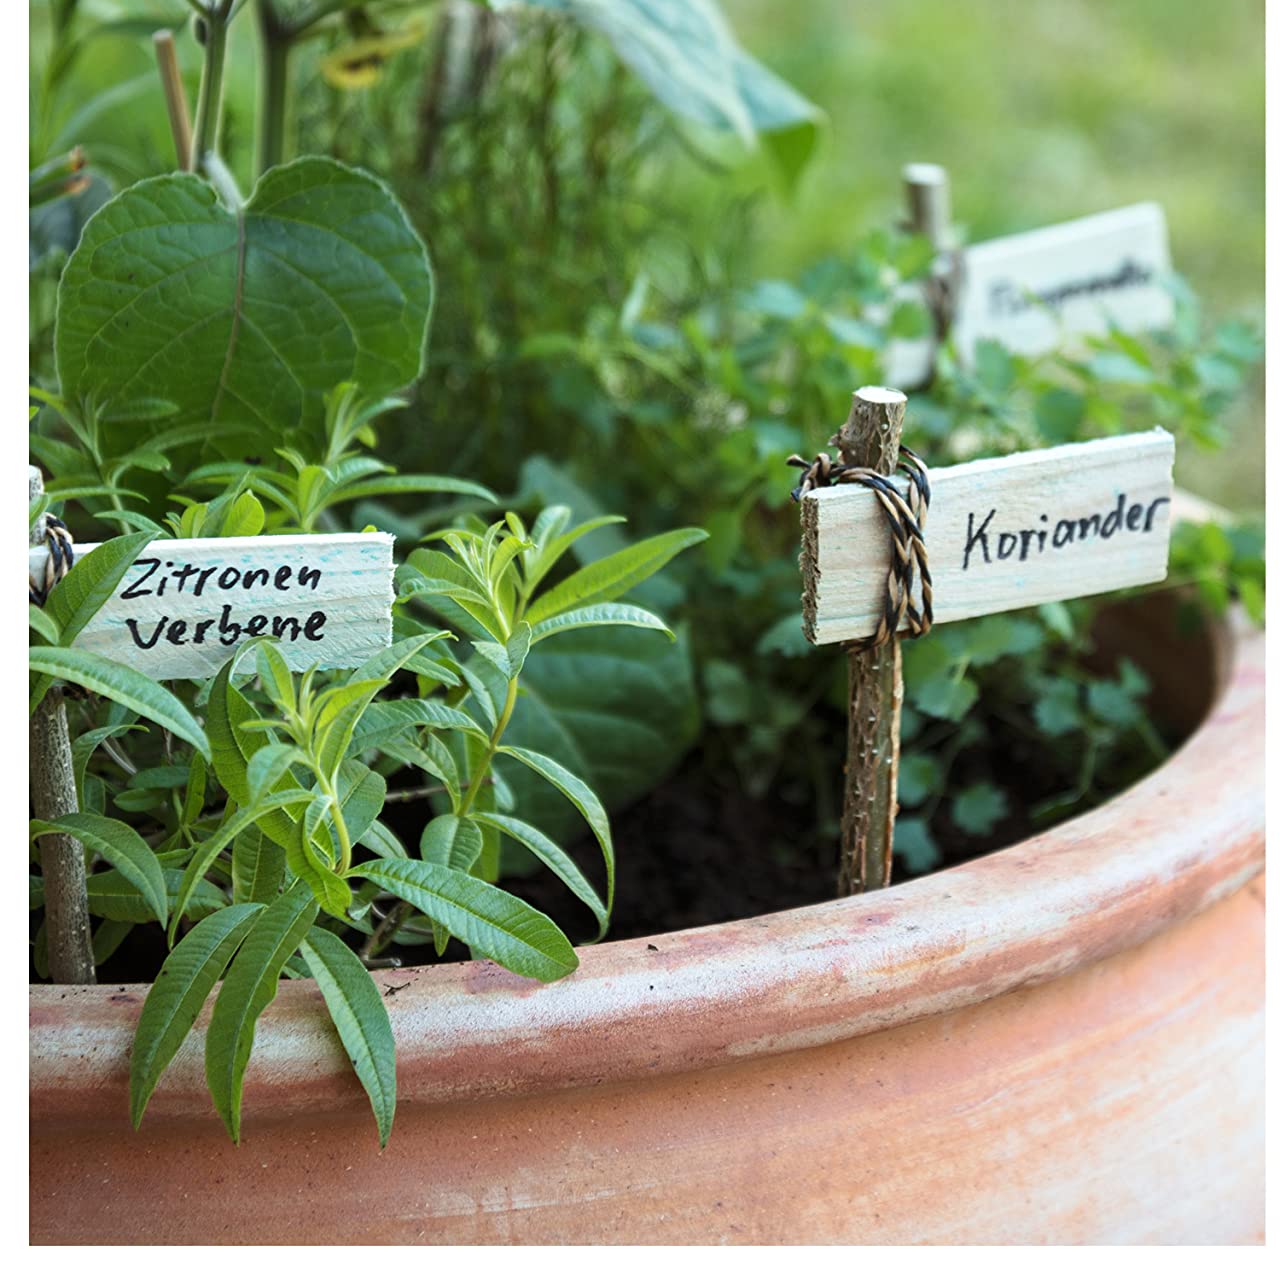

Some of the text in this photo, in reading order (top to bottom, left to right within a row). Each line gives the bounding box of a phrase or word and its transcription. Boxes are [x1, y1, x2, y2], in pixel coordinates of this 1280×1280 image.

[962, 492, 1171, 571] Koriander
[120, 556, 322, 601] Zitronen
[125, 604, 327, 650] Verbene
